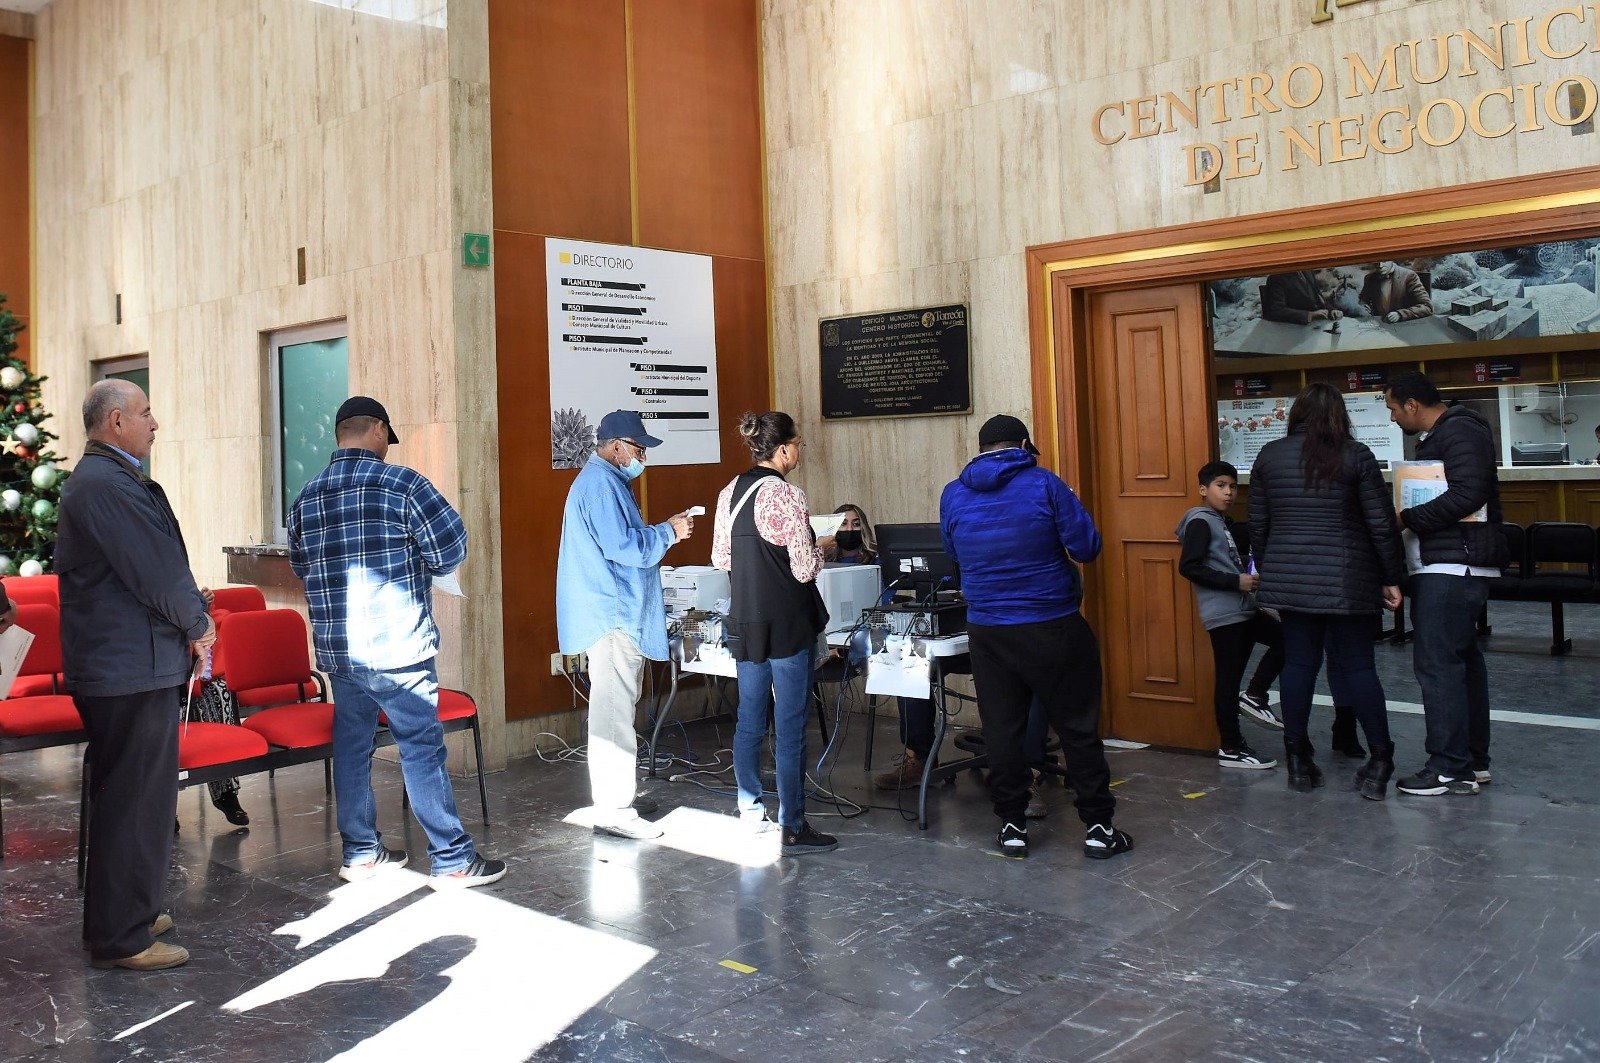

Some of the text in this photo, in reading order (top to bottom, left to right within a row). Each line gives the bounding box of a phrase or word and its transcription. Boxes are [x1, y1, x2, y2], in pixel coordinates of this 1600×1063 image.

[1091, 62, 1324, 145] CENTRO
[1182, 75, 1599, 187] DE NEGOCIO
[572, 253, 633, 270] DIRECTORIO
[861, 313, 918, 325] EDIFICIO MUNICIPAL
[934, 310, 964, 322] Torreón
[861, 320, 919, 333] CENTRO HISTORICO
